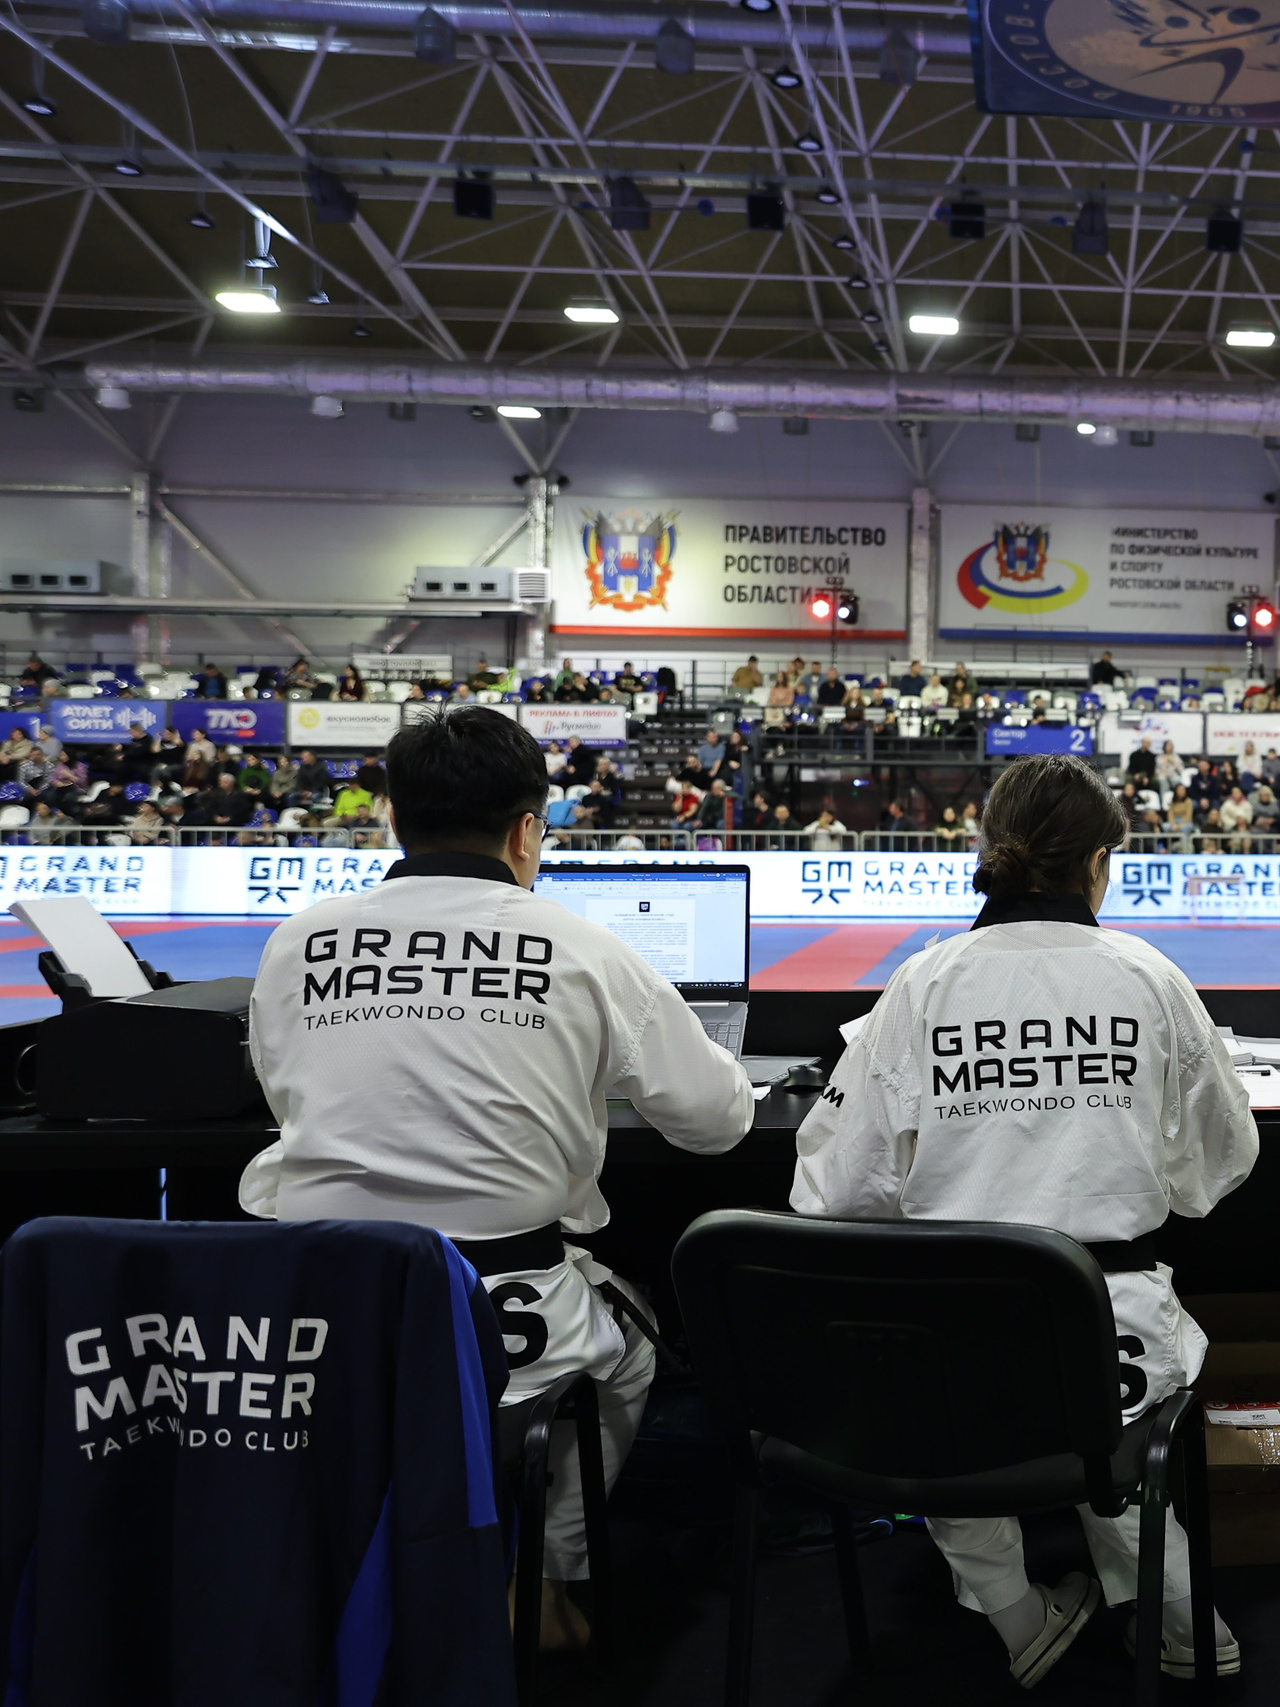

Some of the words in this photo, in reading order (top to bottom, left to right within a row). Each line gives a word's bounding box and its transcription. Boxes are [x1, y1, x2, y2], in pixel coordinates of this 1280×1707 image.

[724, 524, 887, 546] ПРАВИТЕЛЬСТВО
[1111, 527, 1199, 540] МИНИСТЕРСТВО
[1110, 544, 1125, 555] ПО
[1128, 544, 1202, 557] ФИЗИЧЕСКОЙ
[724, 553, 850, 575] РОСТОВСКОЙ
[1110, 561, 1117, 571] И
[1121, 561, 1163, 573] СПОРТУ
[723, 585, 814, 603] ОБЛАСТИ
[1110, 577, 1181, 590] РОСТОВСКОЙ
[1185, 580, 1234, 592] ОБЛАСТИ
[62, 704, 114, 718] АТЛЕТ
[529, 710, 571, 718] РЕКЛАМА
[583, 710, 618, 718] ЛИФТАХ
[68, 718, 114, 731] СИТИ
[1070, 729, 1086, 752] 2
[19, 856, 145, 872] GRAND
[316, 857, 384, 874] GRA
[15, 877, 141, 893] MASTER
[313, 878, 376, 893] MAS
[304, 928, 553, 965] GRAND
[303, 965, 551, 1006] MASTER
[303, 1005, 465, 1031] TAEKWONDO
[480, 1008, 546, 1030] CLUB
[932, 1015, 1139, 1057] GRAND
[932, 1053, 1138, 1096] MASTER
[934, 1096, 1076, 1120] TAEKWONDO
[1086, 1094, 1132, 1110] CLUB
[64, 1313, 330, 1376] GRAND
[74, 1364, 316, 1433] MASTER
[80, 1415, 232, 1461] TAEKWDO
[245, 1430, 309, 1452] CLUB
